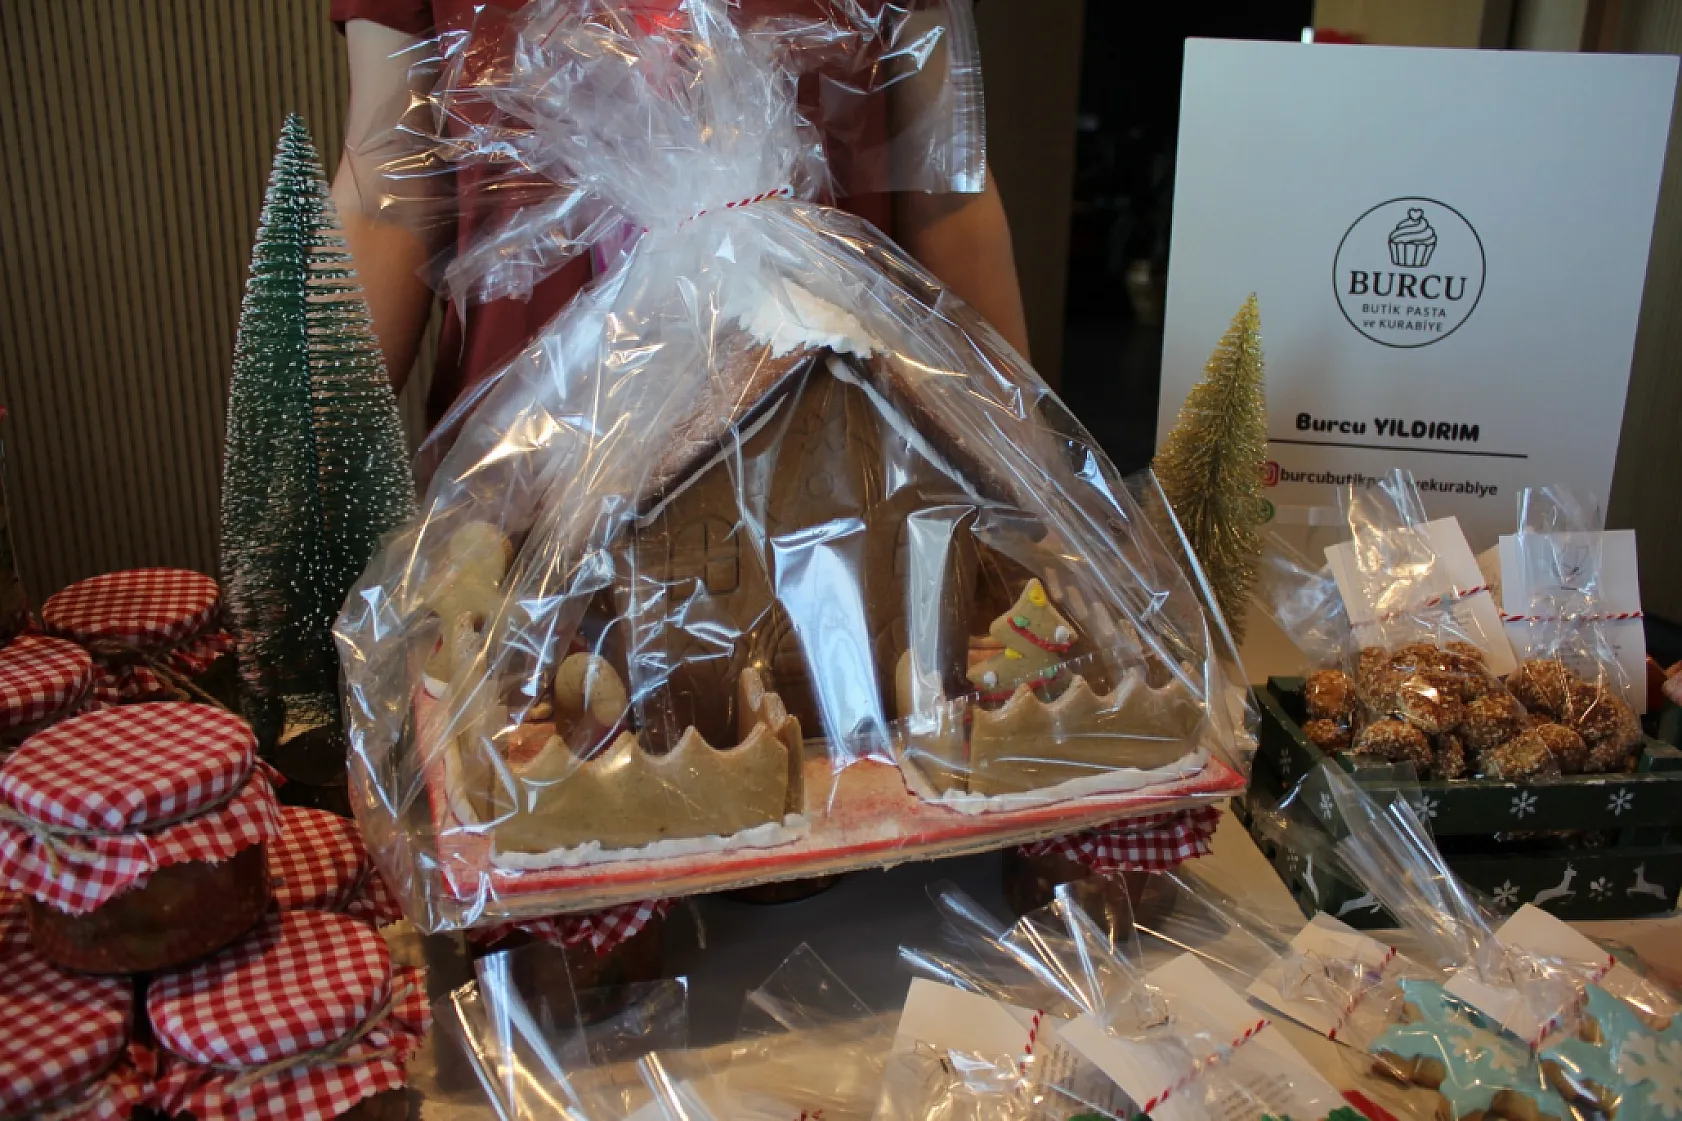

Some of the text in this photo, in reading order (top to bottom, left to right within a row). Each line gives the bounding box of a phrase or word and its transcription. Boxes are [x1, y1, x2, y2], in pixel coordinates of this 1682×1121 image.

[1348, 270, 1468, 301] BURCU
[1362, 302, 1447, 318] BUTİK PASTA
[1363, 319, 1443, 333] ve KURABİYE
[1296, 412, 1480, 441] Burcu YILDIRIM
